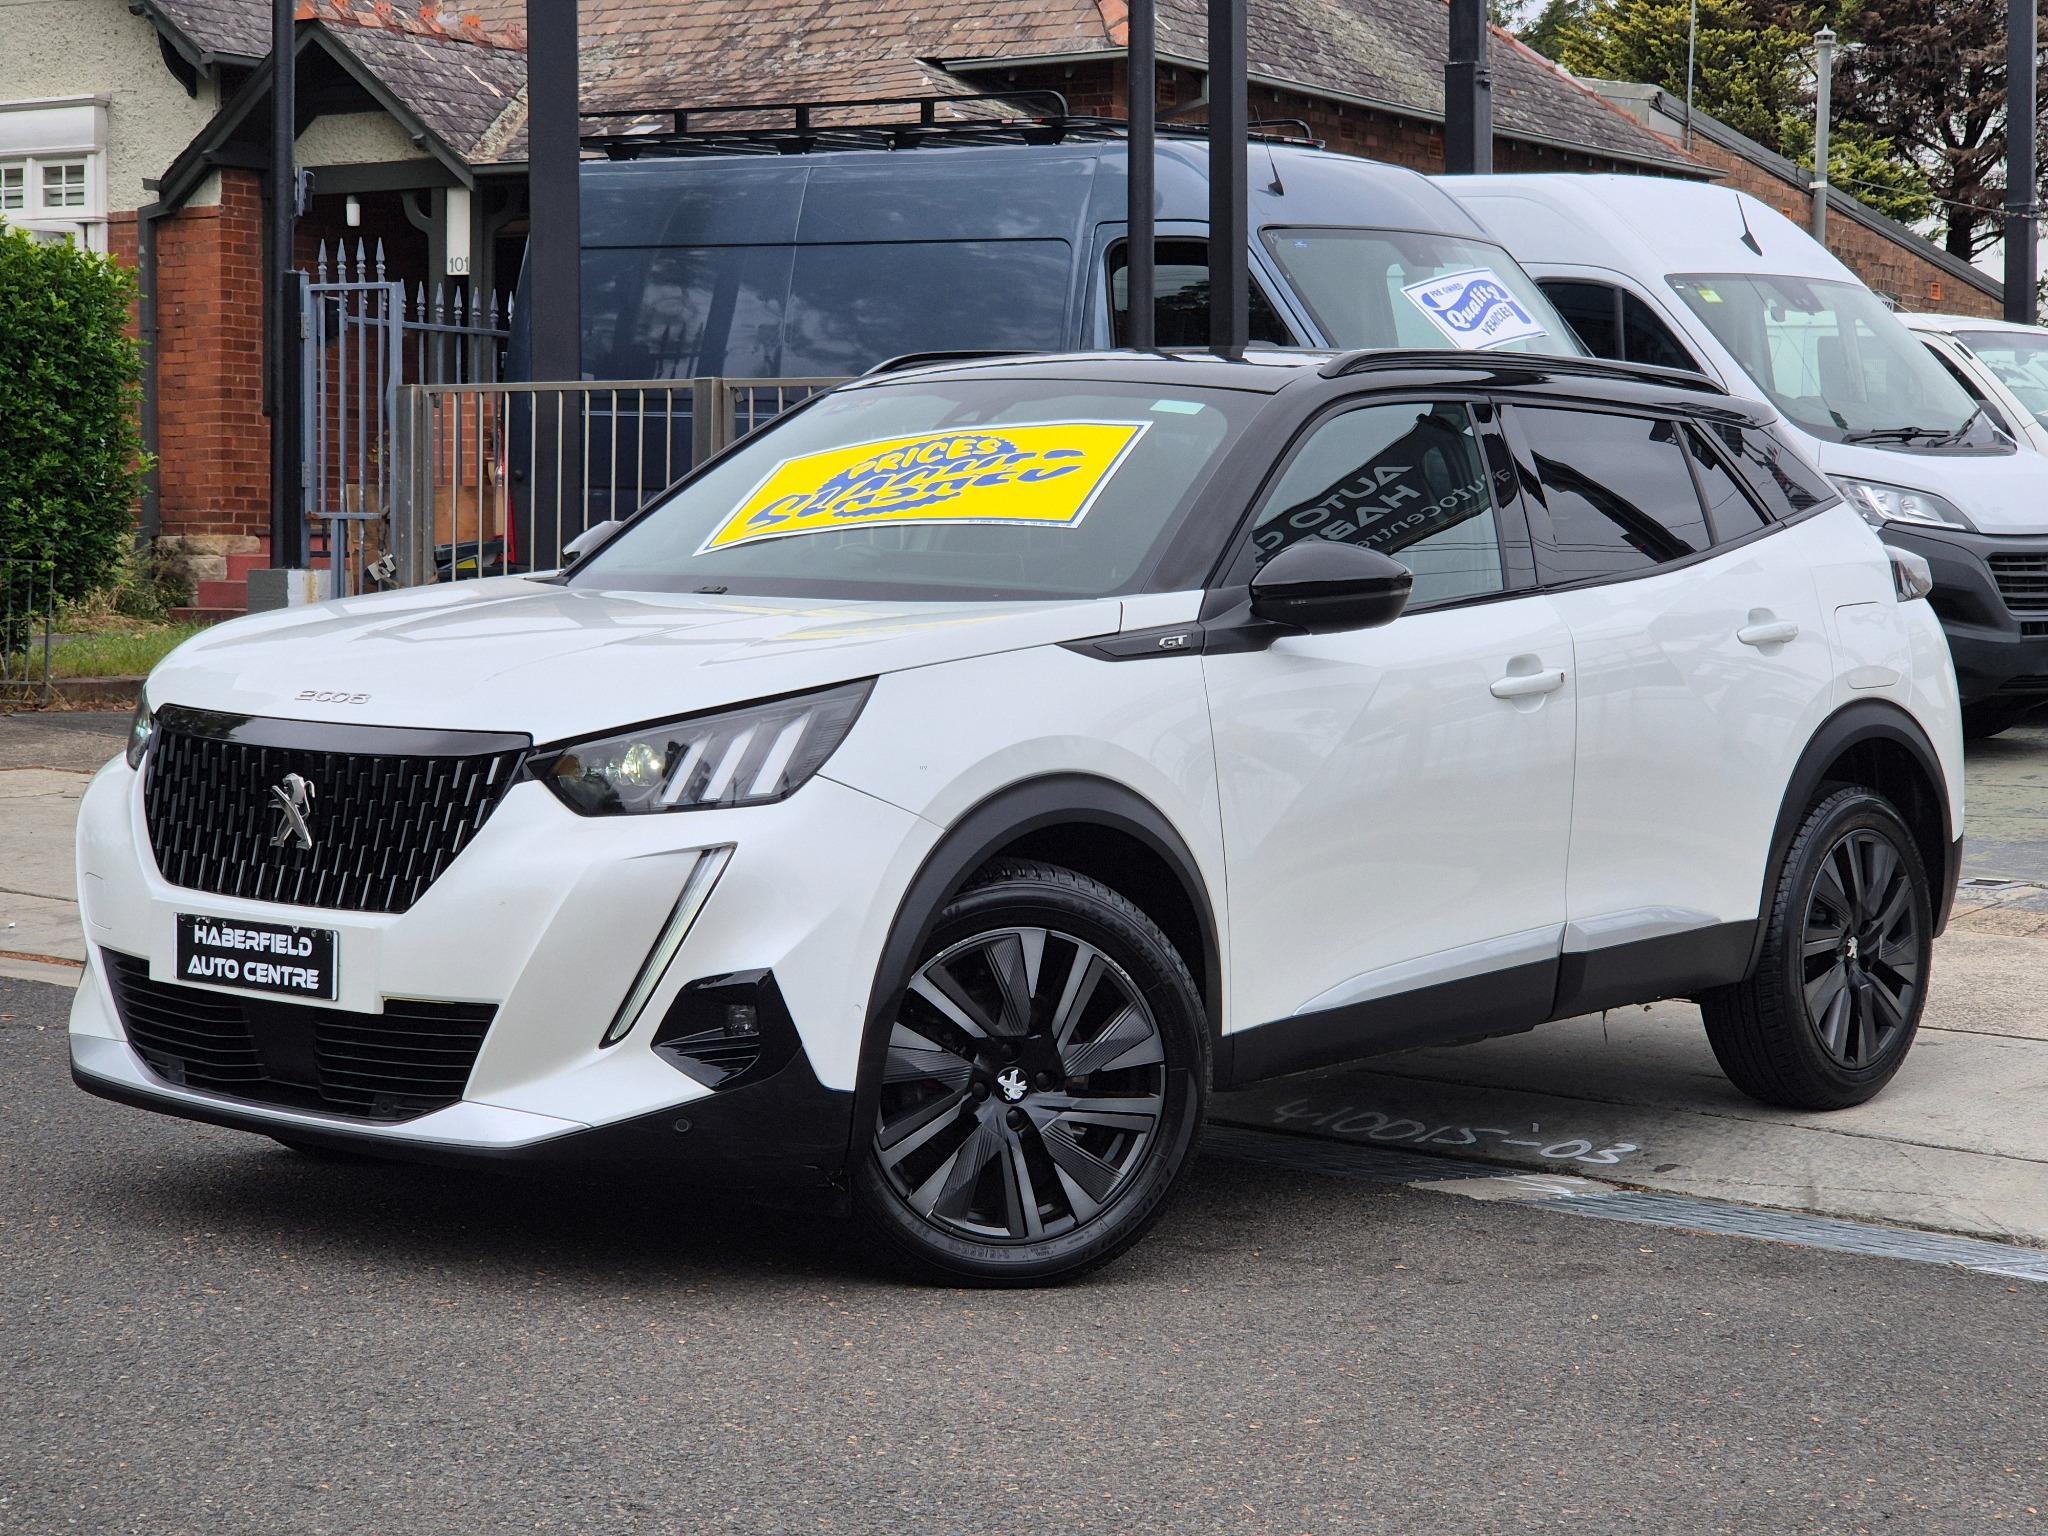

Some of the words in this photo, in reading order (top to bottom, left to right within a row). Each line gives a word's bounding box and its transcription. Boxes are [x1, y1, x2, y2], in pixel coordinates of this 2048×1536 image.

[449, 256, 469, 273] 101
[1446, 284, 1502, 328] Quality
[1481, 305, 1514, 335] VEHICLES
[848, 438, 1001, 479] PRICES
[745, 449, 1087, 531] SLASHED
[1158, 634, 1188, 649] GT
[294, 690, 372, 705] 2008
[194, 924, 313, 957] HABERFIELD
[187, 954, 240, 980] AUTO
[243, 960, 320, 990] CENTRE
